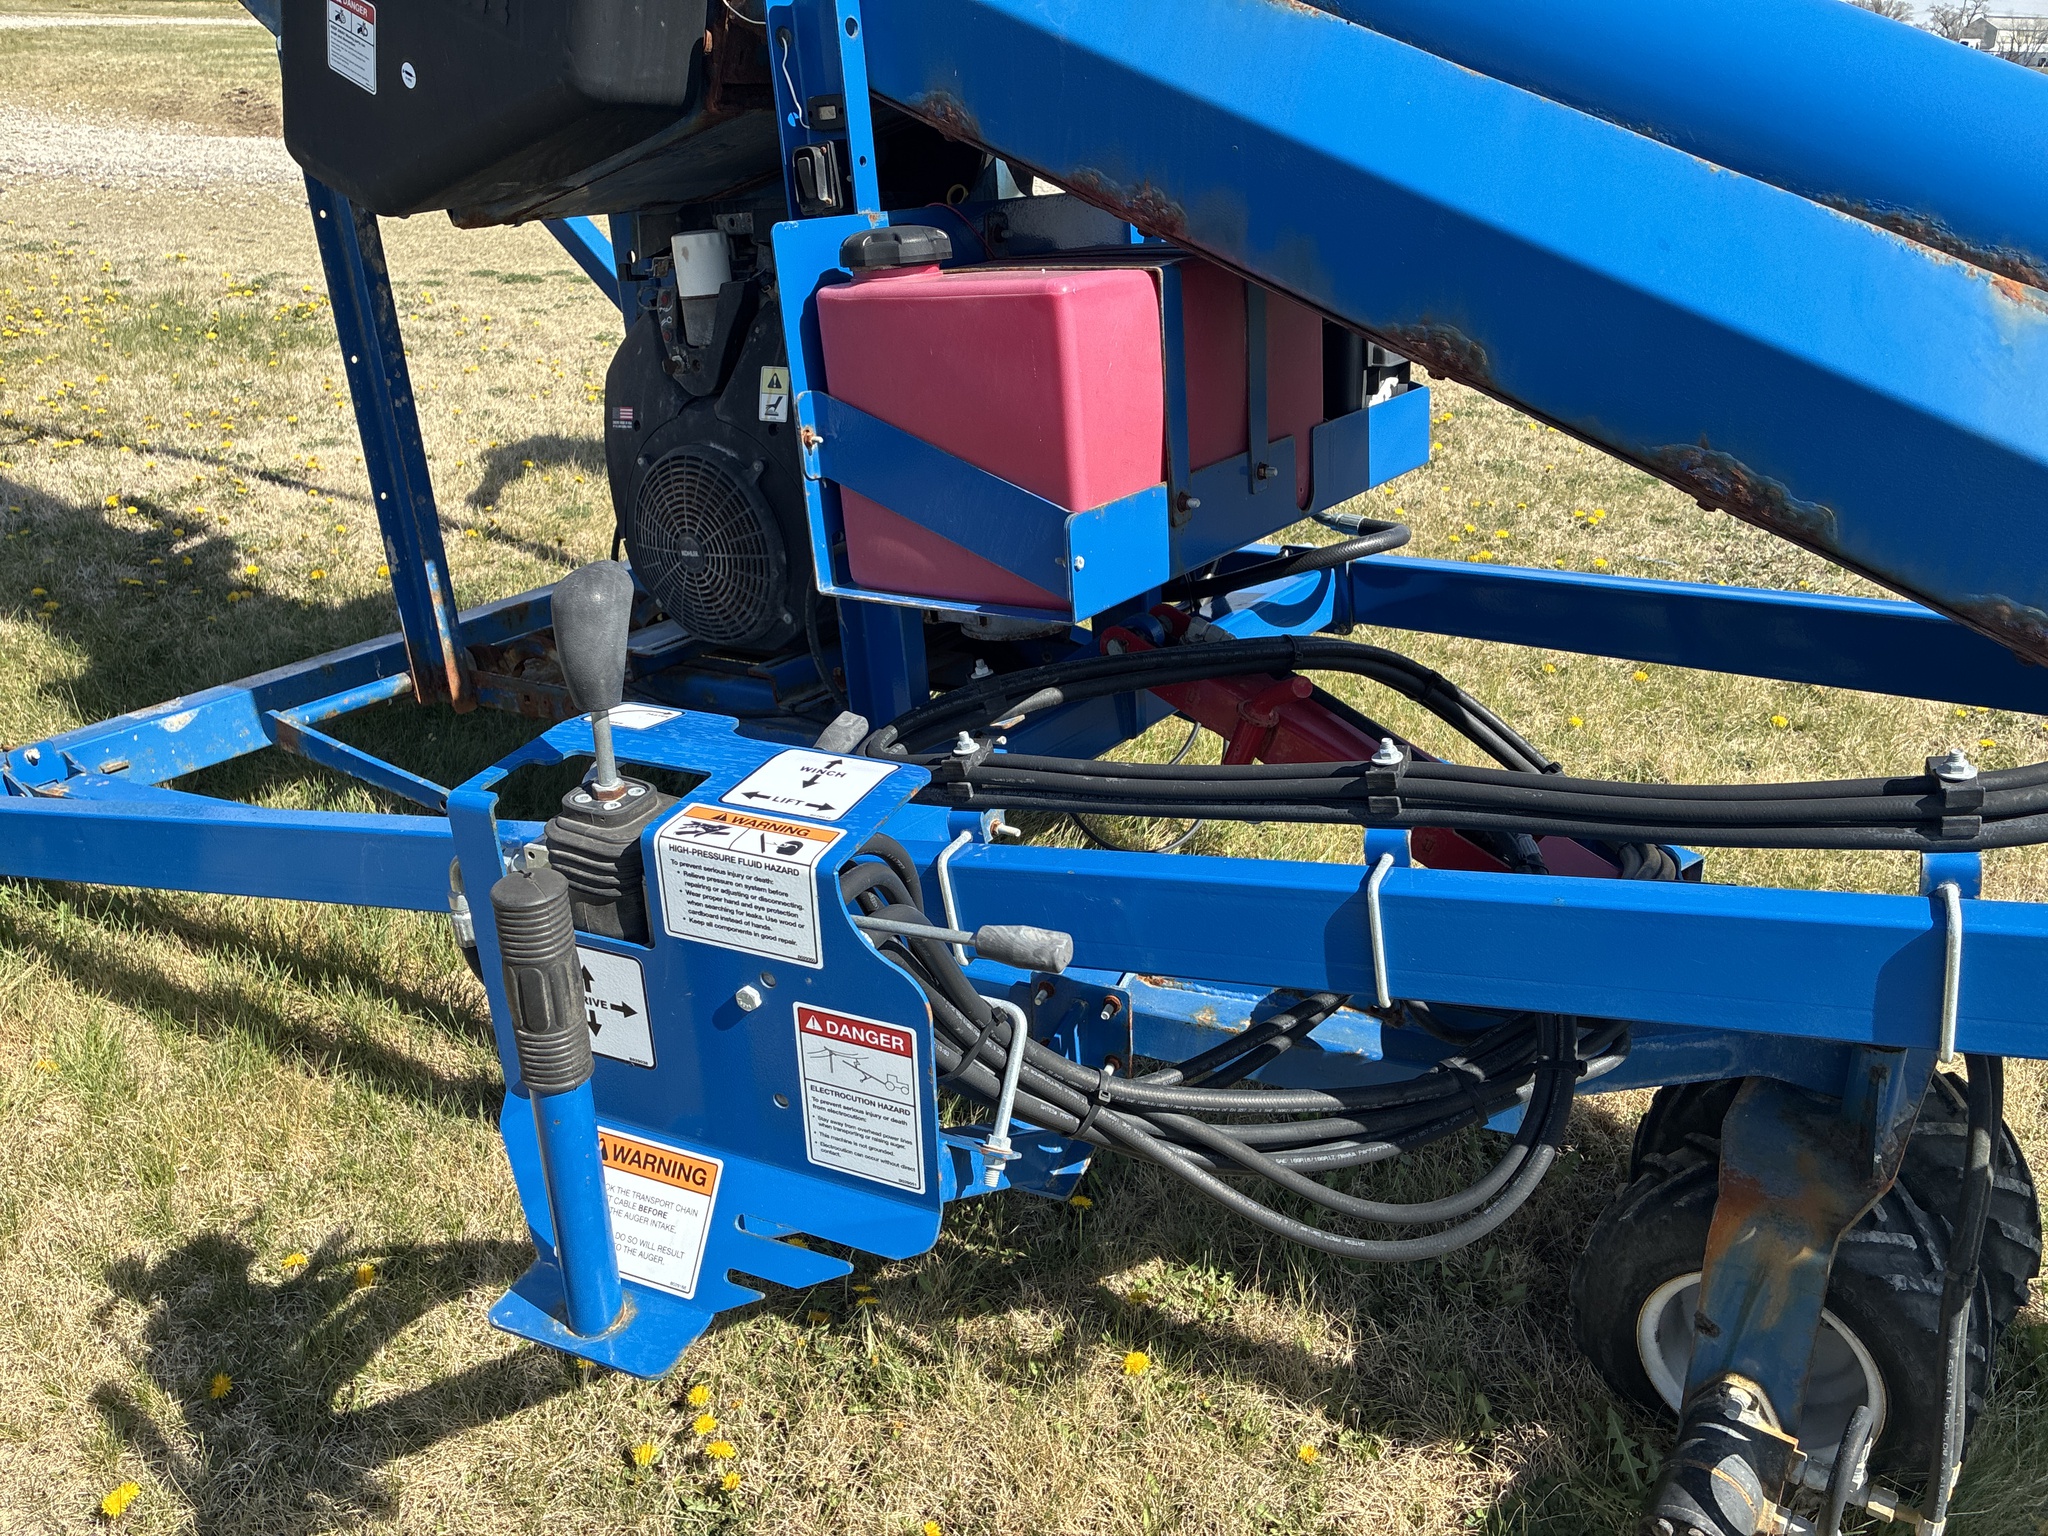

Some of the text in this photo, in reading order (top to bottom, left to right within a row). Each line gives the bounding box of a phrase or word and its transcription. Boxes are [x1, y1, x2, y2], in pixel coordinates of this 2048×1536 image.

[800, 765, 847, 779] WINCH
[771, 795, 805, 807] LIFT
[731, 816, 811, 837] WARNING
[669, 844, 799, 876] HIGH-PRESSURE FLUID HAZARD
[679, 860, 702, 871] prevent
[703, 866, 726, 875] serious
[727, 870, 744, 880] injury
[754, 875, 774, 885] death:
[683, 871, 705, 880] Relieve
[707, 876, 733, 887] pressure
[744, 884, 766, 894] system
[768, 887, 788, 897] before
[685, 881, 711, 892] repairing
[720, 888, 749, 900] adjusting
[758, 895, 804, 911] disconnecting.
[685, 889, 701, 898] Wear
[702, 894, 722, 904] proper
[724, 896, 739, 905] hand
[741, 900, 752, 908] and
[767, 906, 798, 918] protection
[687, 900, 703, 908] when
[705, 903, 734, 916] searching
[746, 911, 764, 920] leaks.
[765, 915, 777, 923] Use
[779, 918, 796, 928] wood
[688, 909, 719, 920] cardboard
[720, 915, 742, 925] instead
[751, 921, 772, 931] hands.
[689, 917, 705, 927] Keep
[715, 923, 752, 936] components
[761, 933, 777, 942] good
[778, 936, 797, 946] repair.
[584, 996, 608, 1009] RIVE
[826, 1020, 904, 1051] DANGER
[811, 1085, 911, 1116] ELECTROCUTION HAZARD
[812, 1104, 866, 1122] from electrocution:
[820, 1098, 841, 1111] prevent
[843, 1104, 864, 1115] serious
[865, 1109, 881, 1120] injury
[890, 1116, 907, 1126] death
[818, 1116, 912, 1145] Stay away from overhead power lines
[819, 1123, 832, 1131] when
[833, 1126, 864, 1139] transporting
[872, 1136, 889, 1146] raising
[890, 1141, 906, 1149] auger.
[819, 1131, 829, 1139] This
[831, 1134, 852, 1145] machine
[868, 1144, 895, 1156] grounded.
[613, 1144, 707, 1187] WARNING
[820, 1142, 852, 1154] Electrocution
[880, 1157, 899, 1168] without
[901, 1162, 916, 1172] direct
[821, 1148, 841, 1158] contact.
[614, 1198, 637, 1211] CABLE
[638, 1205, 668, 1219] BEFORE
[617, 1186, 630, 1197] THE
[632, 1191, 674, 1210] TRANSPORT
[676, 1204, 698, 1217] CHAIN
[610, 1207, 677, 1234] THE AUGER INTAKE.
[615, 1232, 685, 1259] DO SO WILL RESULT
[623, 1246, 637, 1256] THE
[638, 1251, 665, 1265] AUGER.
